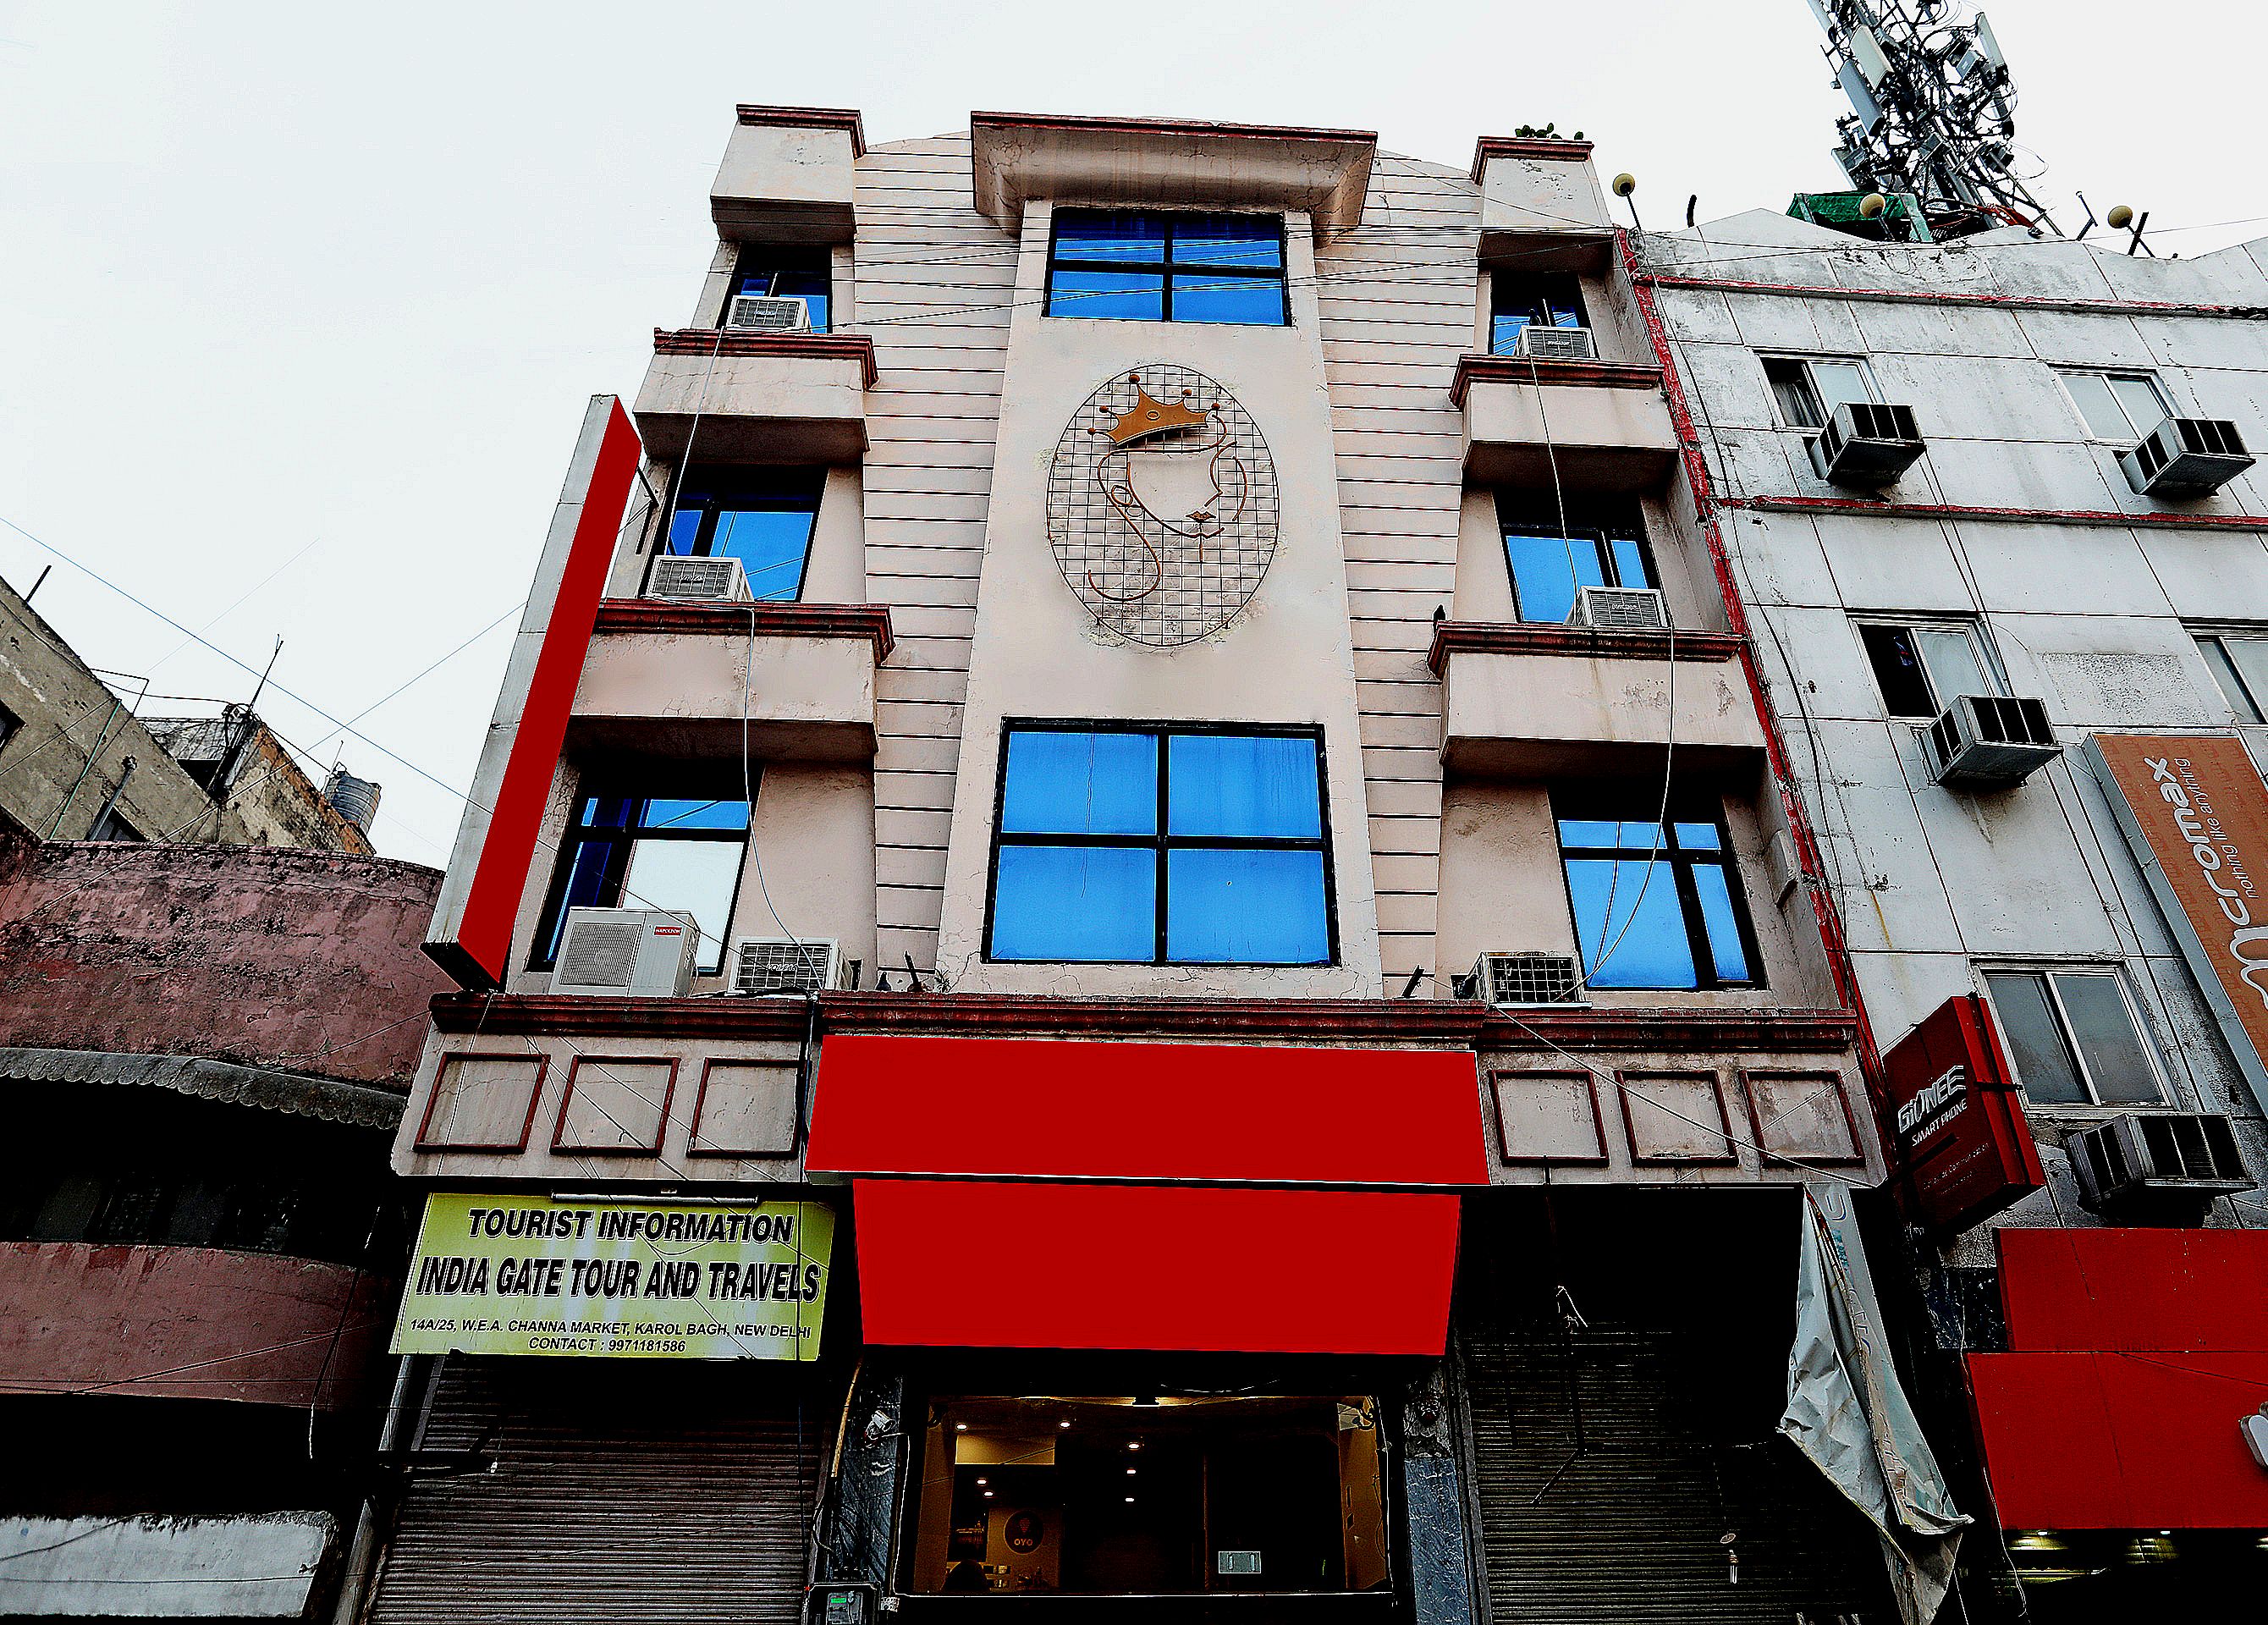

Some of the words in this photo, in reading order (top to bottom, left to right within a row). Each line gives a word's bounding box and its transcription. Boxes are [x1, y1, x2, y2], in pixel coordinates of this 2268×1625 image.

[2175, 757, 2214, 815] anything
[2207, 815, 2228, 840] like
[2220, 844, 2259, 898] nothing
[1912, 1117, 1940, 1146] SMART
[1940, 1099, 1968, 1127] PHONE
[468, 1209, 594, 1239] TOURIST
[597, 1210, 795, 1244] INFORMATION
[415, 1256, 490, 1297] INDIA
[496, 1256, 567, 1297] GATE
[570, 1258, 641, 1299] TOUR
[642, 1259, 702, 1301] AND
[707, 1261, 822, 1303] TRAVELS
[410, 1319, 457, 1333] 14A/25,
[462, 1319, 504, 1332] W.E.A.
[508, 1319, 566, 1333] CHANNA
[570, 1321, 630, 1336] MARKET,
[635, 1322, 683, 1336] KAROL
[686, 1323, 730, 1337] BAGH,
[734, 1325, 768, 1336] NEW
[769, 1325, 812, 1338] DELHI
[529, 1336, 597, 1351] CONTACT
[608, 1339, 686, 1352] 9971181586
[1014, 1538, 1033, 1546] OYO
